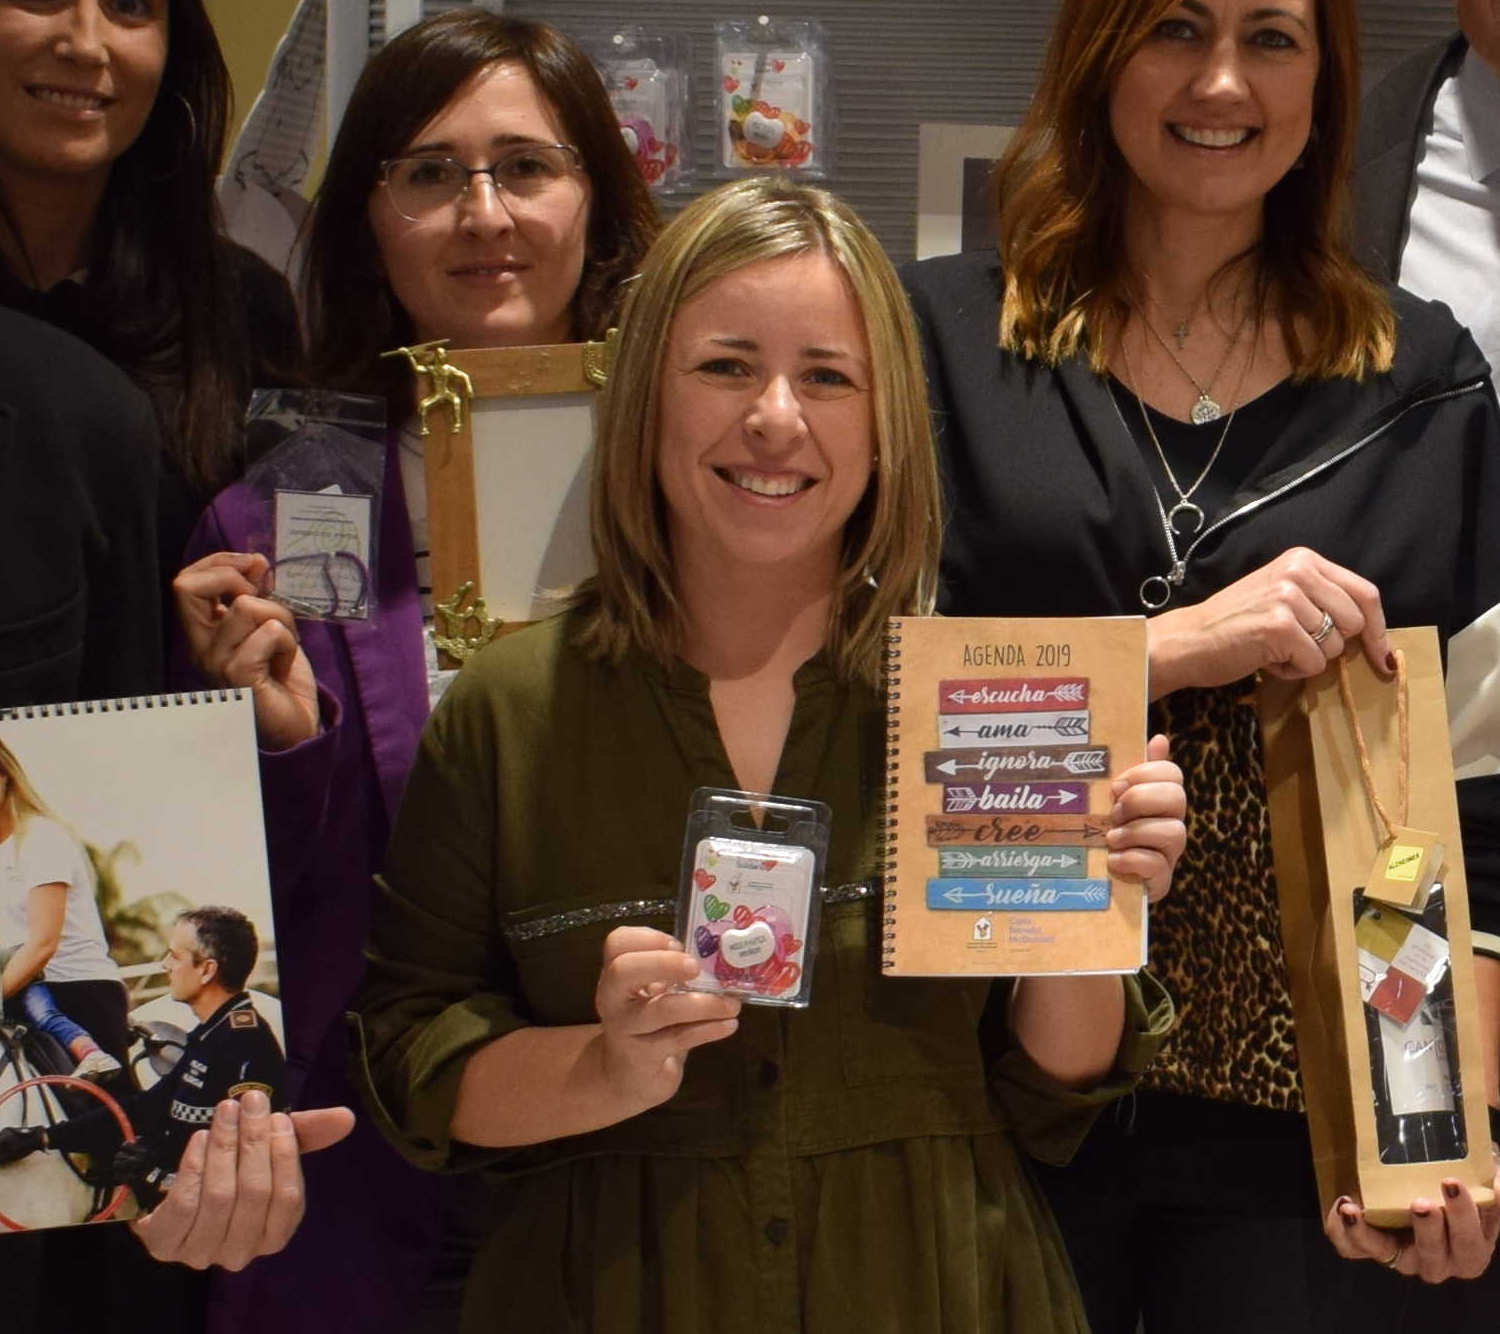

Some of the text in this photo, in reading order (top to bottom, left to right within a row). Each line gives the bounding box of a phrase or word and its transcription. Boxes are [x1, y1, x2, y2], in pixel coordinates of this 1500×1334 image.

[962, 643, 1072, 668] AGENDA 2019
[970, 682, 1049, 705] escucha
[977, 721, 1033, 739] ama
[977, 749, 1053, 781] ignora
[977, 784, 1048, 813] baila
[978, 847, 1054, 875] arriesga
[984, 880, 1062, 907] sueña
